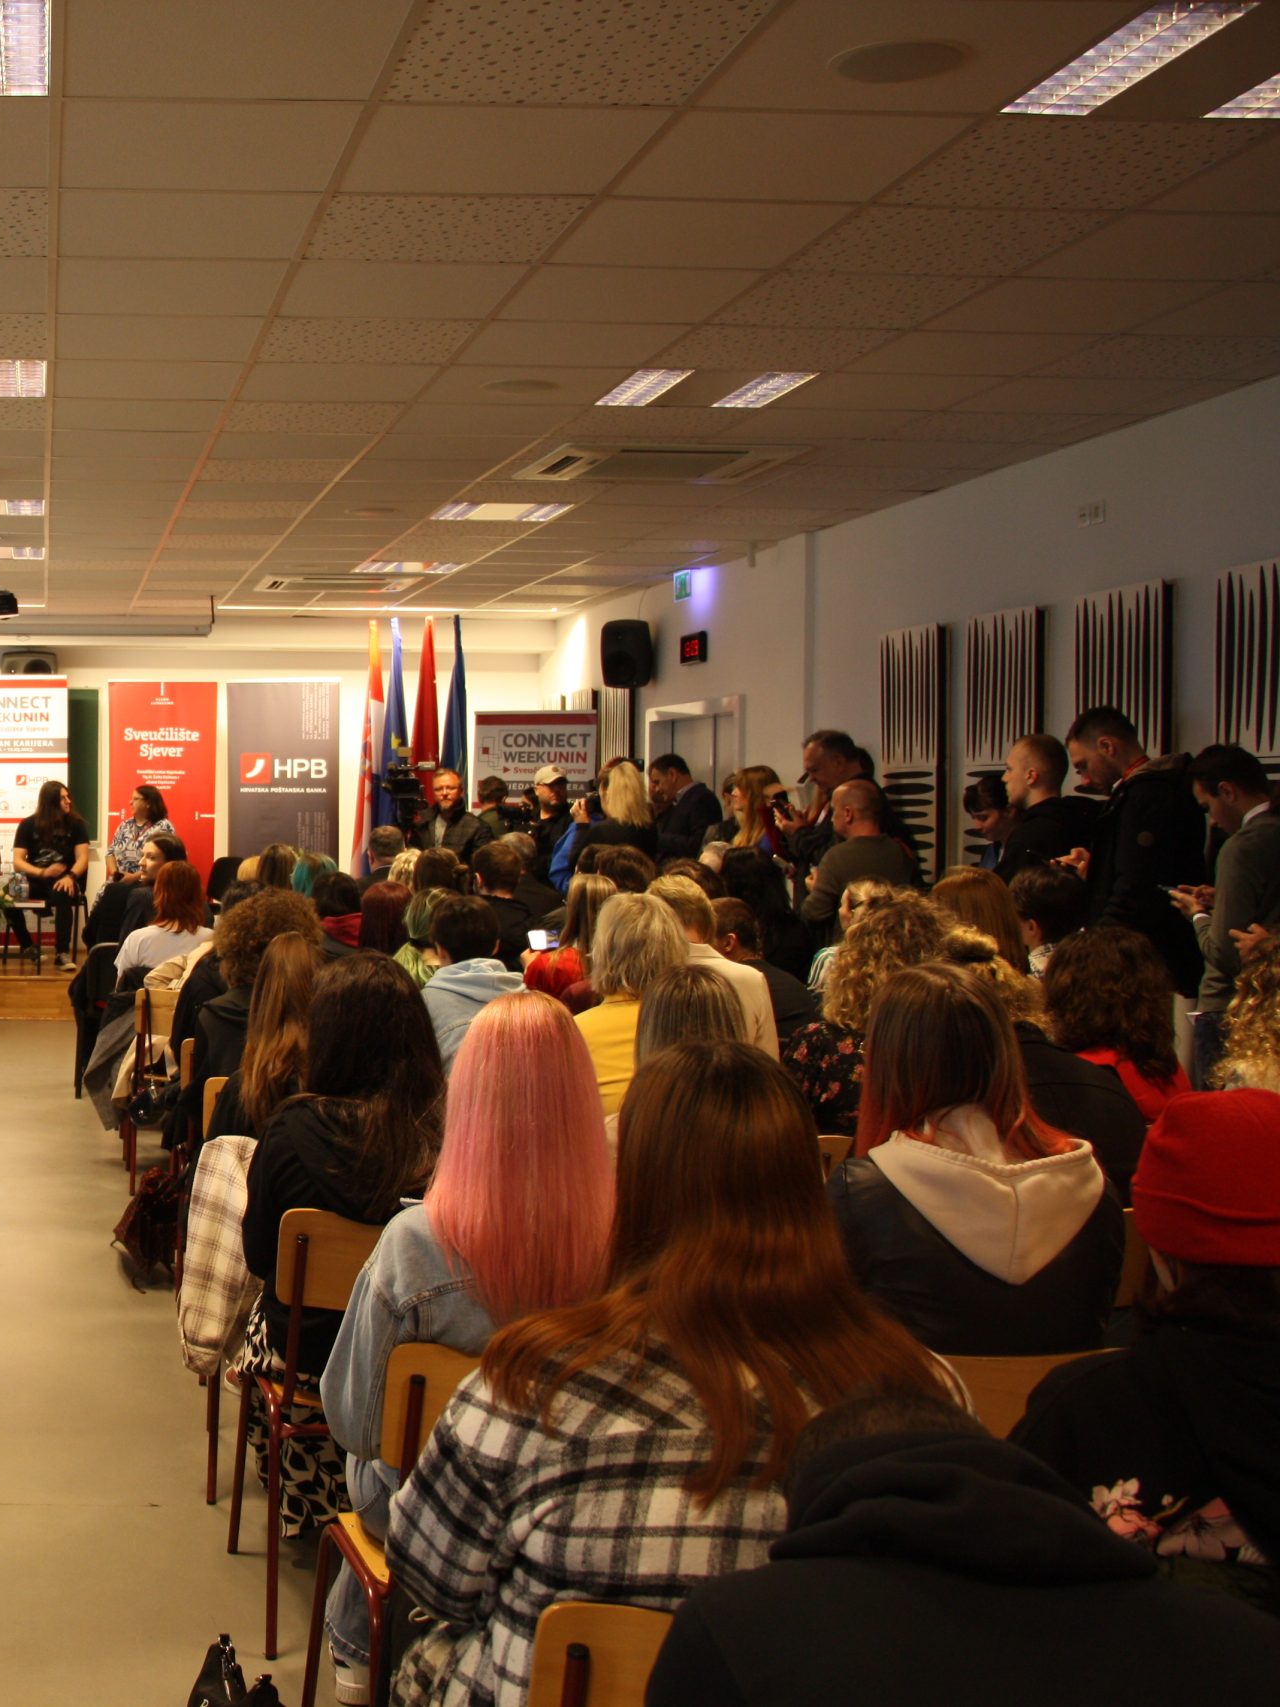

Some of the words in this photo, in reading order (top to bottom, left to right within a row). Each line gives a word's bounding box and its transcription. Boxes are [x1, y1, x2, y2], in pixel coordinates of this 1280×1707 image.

[124, 727, 200, 741] Sveučilište
[502, 733, 591, 748] CONNECT
[139, 743, 184, 760] Sjever
[503, 751, 587, 764] WEEKUNIN
[274, 758, 328, 779] HPB
